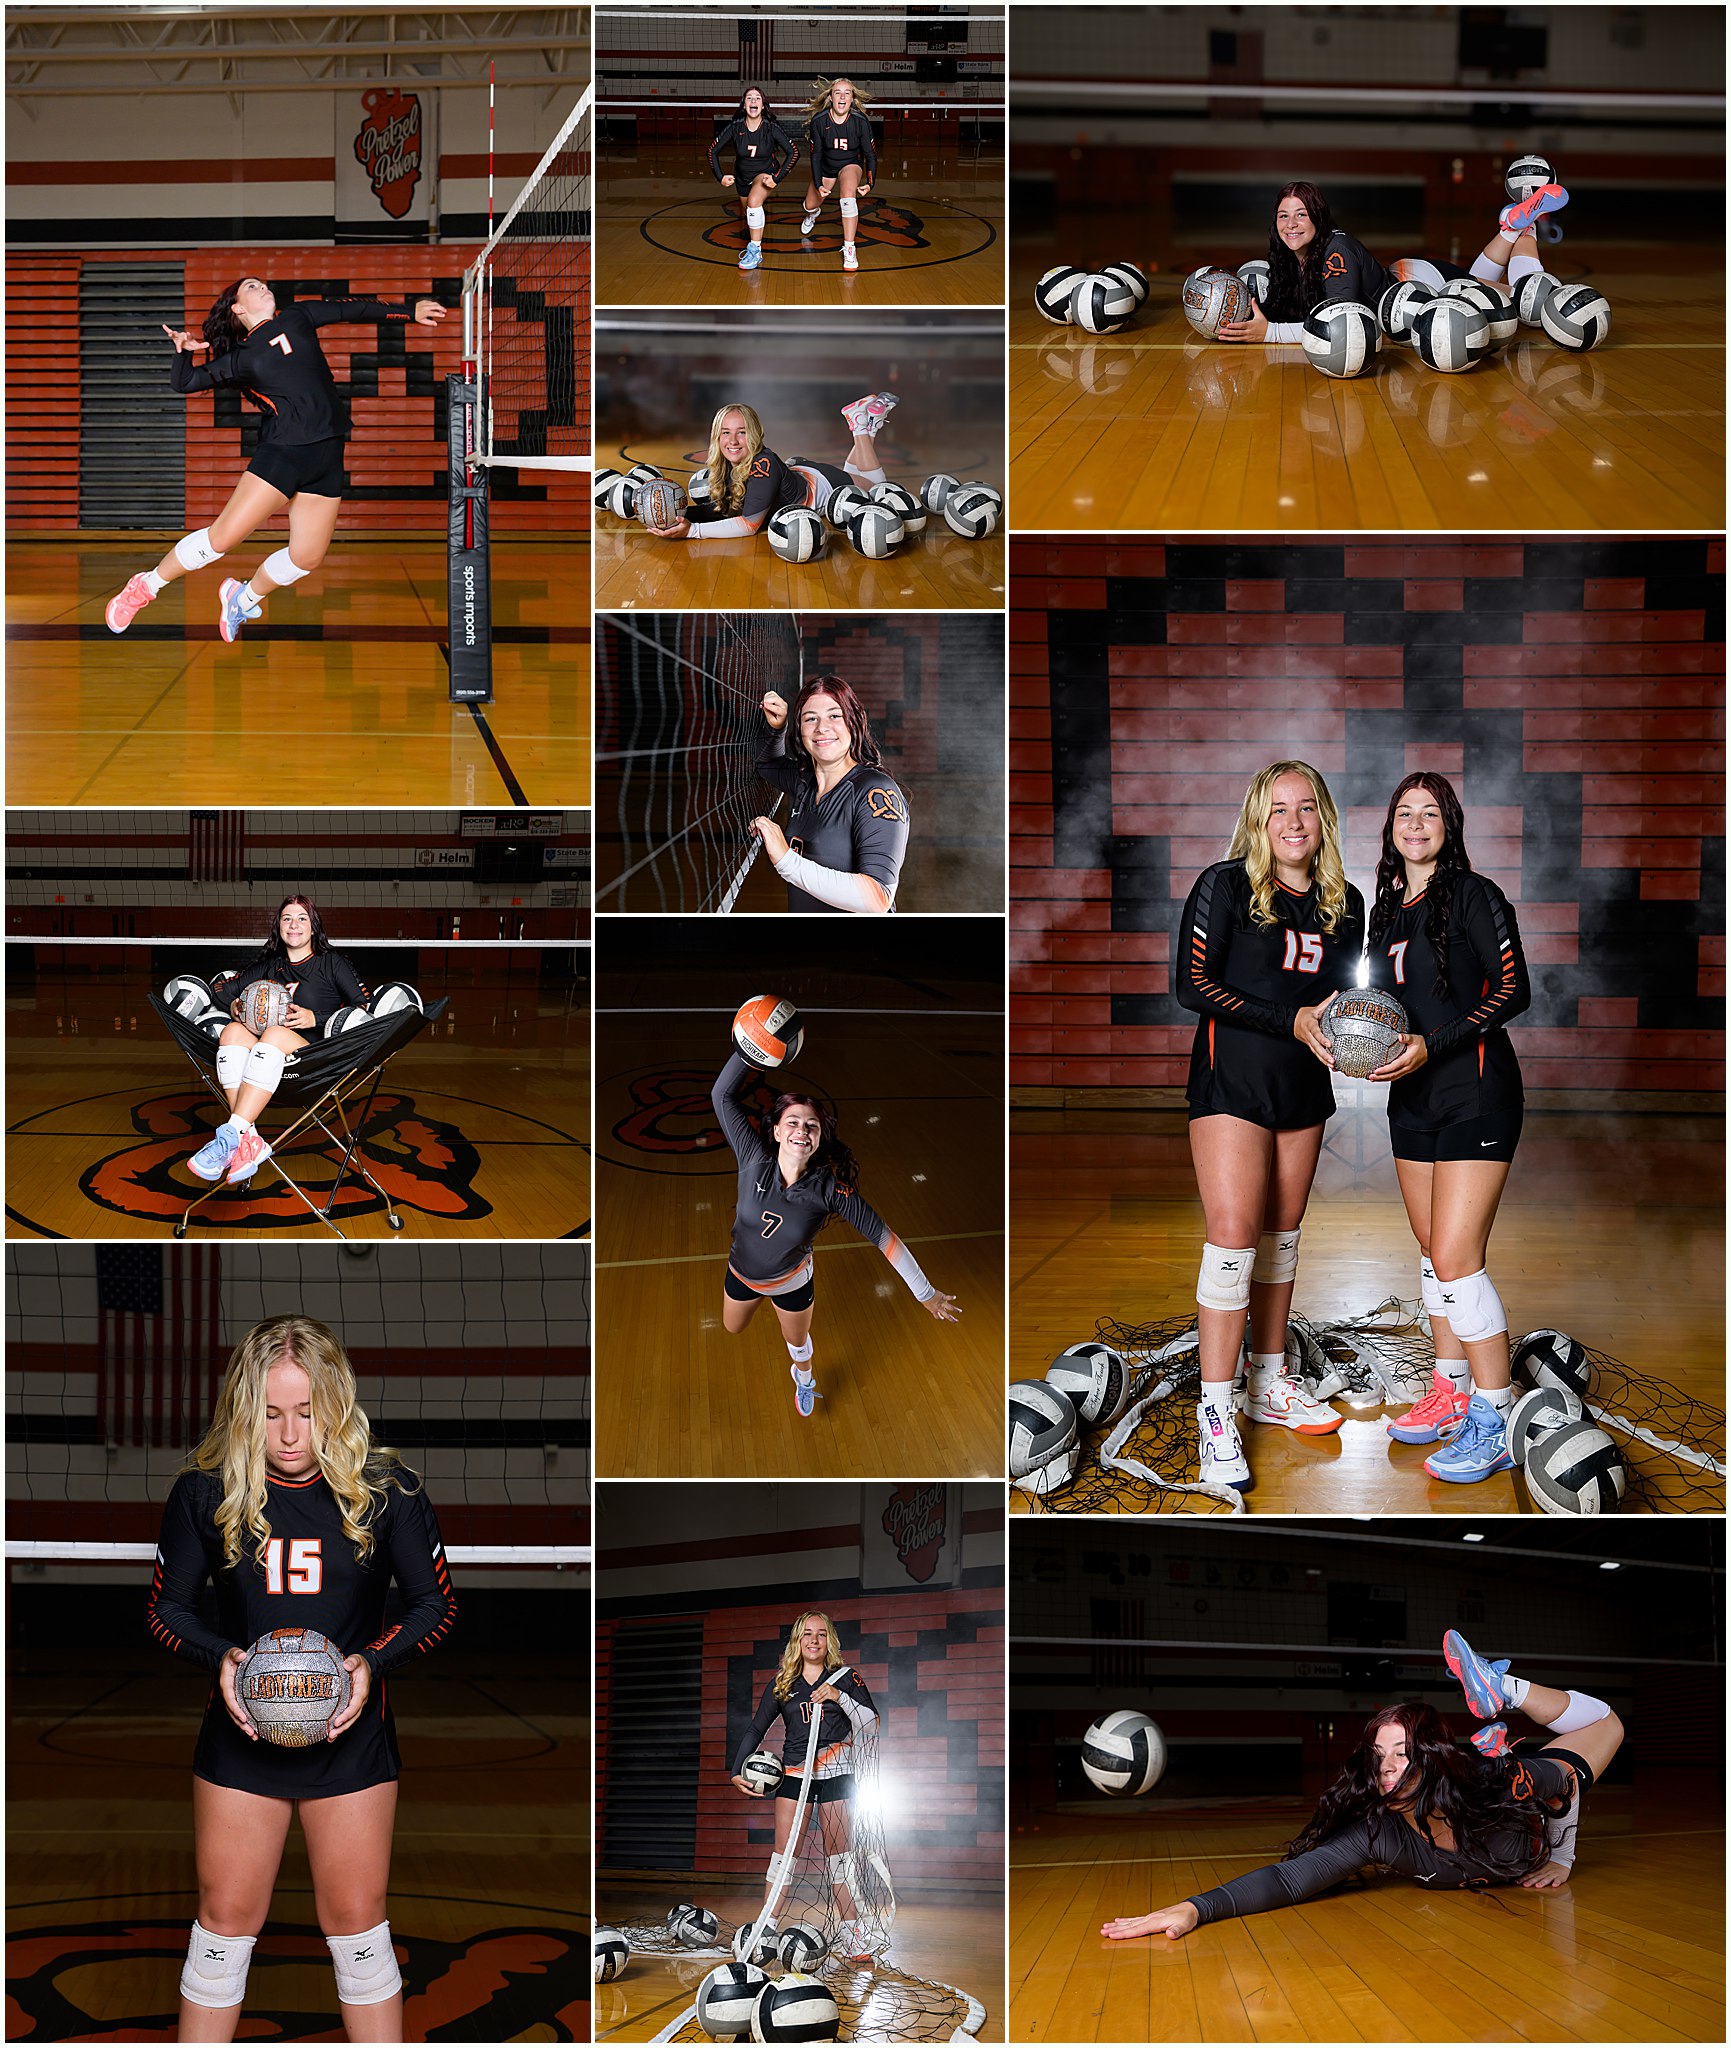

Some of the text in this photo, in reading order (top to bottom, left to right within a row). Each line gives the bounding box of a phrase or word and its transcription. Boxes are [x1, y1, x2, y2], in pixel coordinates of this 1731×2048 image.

[362, 103, 419, 162] Pretzel
[747, 145, 757, 157] 7
[833, 138, 848, 151] 15
[374, 151, 418, 189] Power
[268, 333, 293, 356] 7
[463, 565, 475, 646] sports imports
[439, 853, 470, 863] Helm
[1282, 928, 1323, 973] 15
[1388, 939, 1409, 984] 7
[1336, 1000, 1367, 1018] LADY
[761, 1211, 783, 1239] 7
[1102, 1362, 1120, 1413] molten
[889, 1482, 944, 1533] Pretzel
[901, 1518, 943, 1556] Power
[265, 1538, 323, 1595] 15
[250, 1674, 287, 1699] LADY
